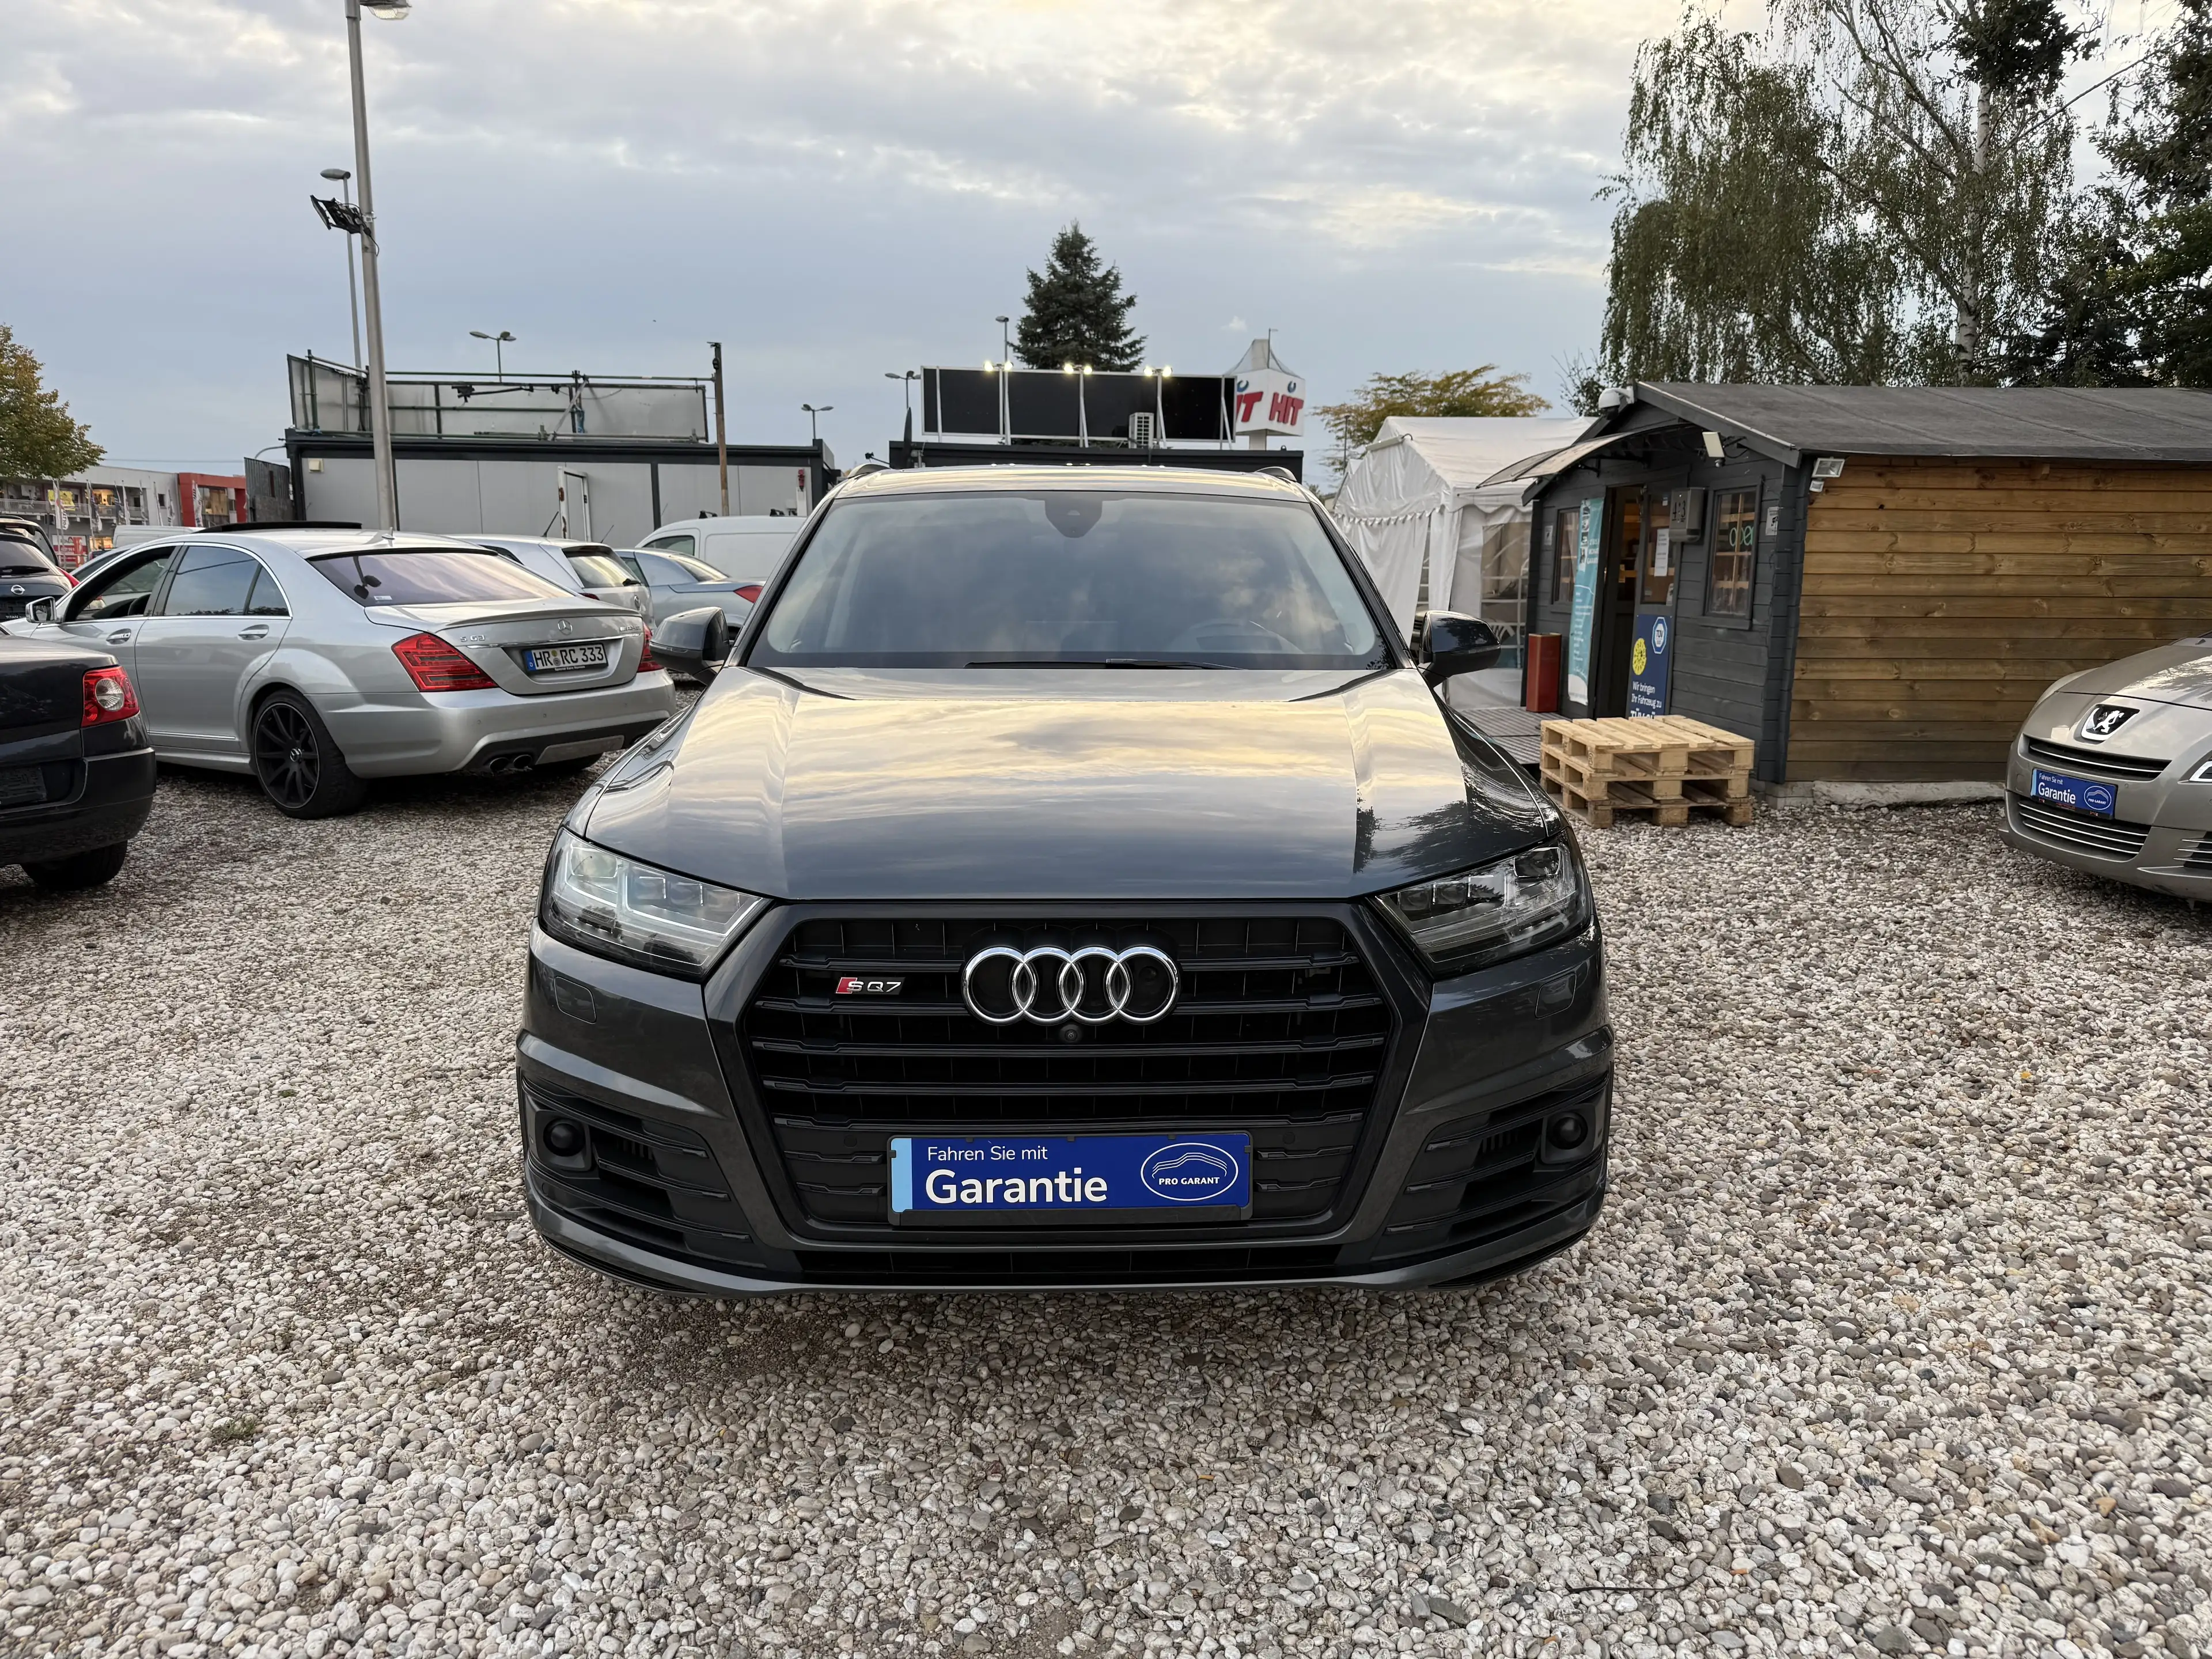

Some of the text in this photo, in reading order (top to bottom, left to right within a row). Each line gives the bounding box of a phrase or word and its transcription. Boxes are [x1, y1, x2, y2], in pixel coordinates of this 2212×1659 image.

[1236, 391, 1264, 422] IT
[1269, 392, 1304, 426] HIT
[533, 651, 553, 667] HR
[559, 649, 578, 665] RC
[579, 646, 604, 662] 333
[1639, 682, 1655, 695] bringen
[1638, 694, 1656, 709] Fahrzeug
[1656, 700, 1662, 708] zu
[2039, 773, 2051, 781] Fahren
[2038, 782, 2076, 804] Garantie
[927, 1145, 1048, 1161] Fahren Sie mit
[926, 1167, 1108, 1204] Garantie
[1181, 1177, 1220, 1185] GARANT
